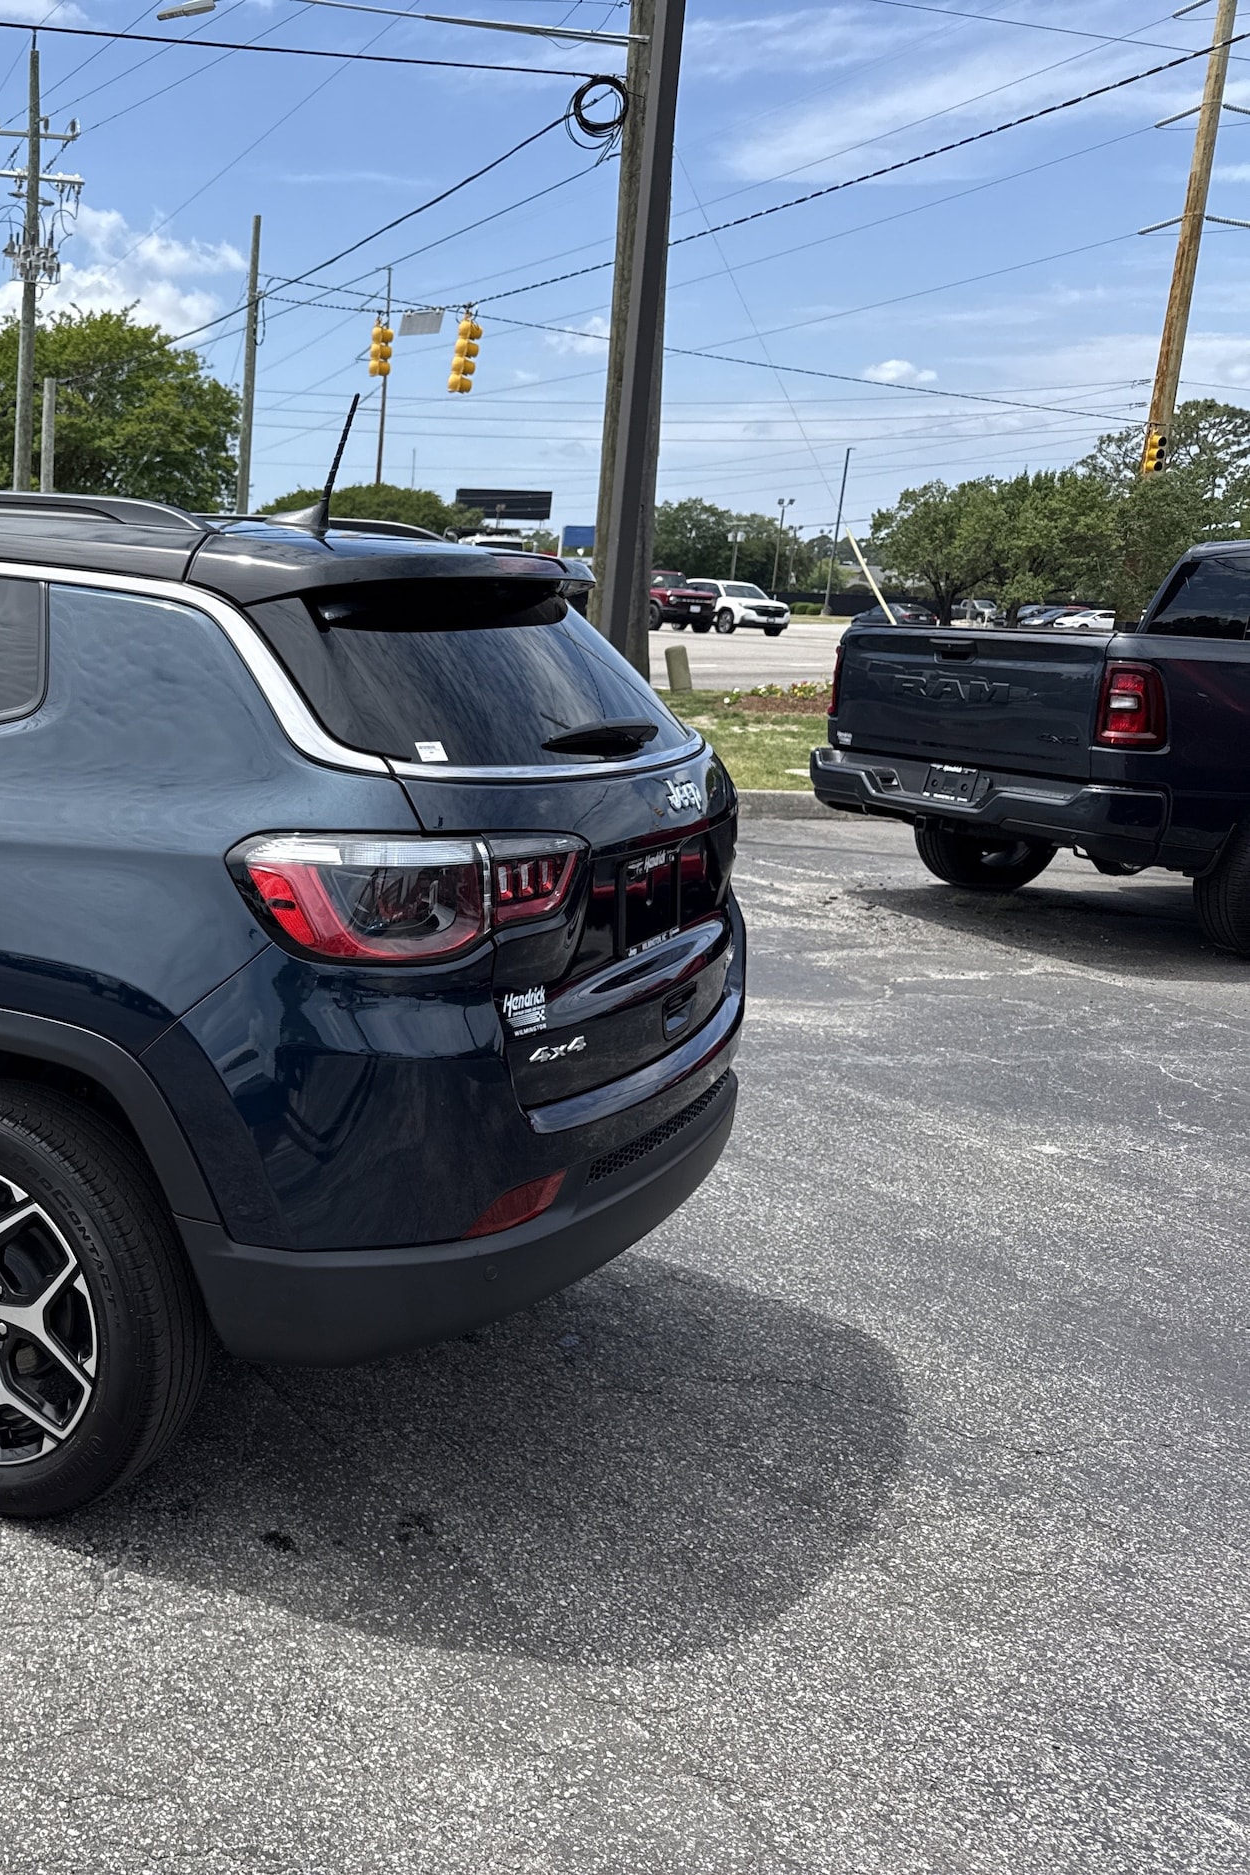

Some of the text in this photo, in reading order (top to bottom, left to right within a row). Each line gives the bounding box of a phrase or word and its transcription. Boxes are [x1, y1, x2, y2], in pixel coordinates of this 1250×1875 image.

[894, 675, 1010, 704] RAM
[663, 778, 703, 815] Jeep
[502, 984, 546, 1018] Hendrick
[513, 1023, 548, 1037] WILMINGTON
